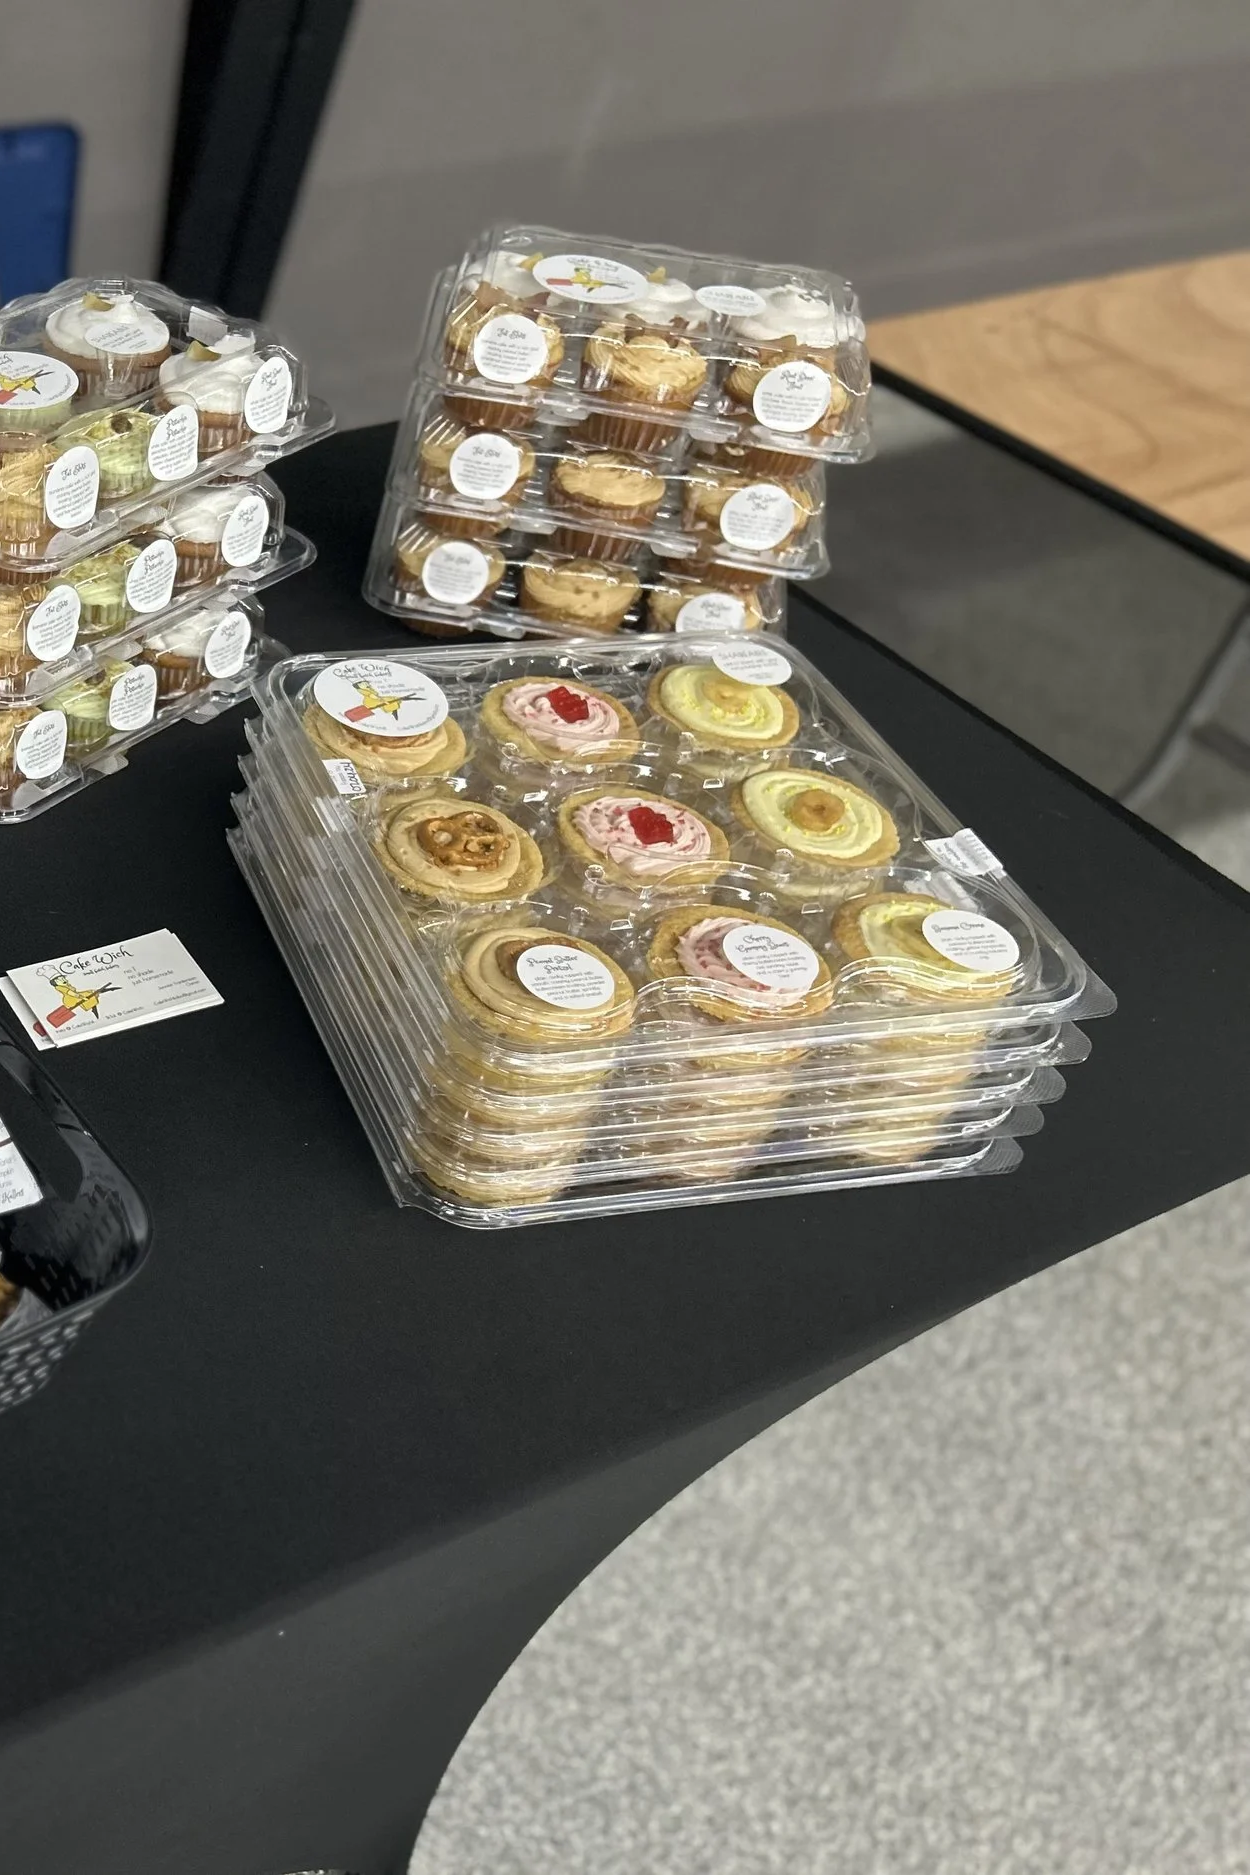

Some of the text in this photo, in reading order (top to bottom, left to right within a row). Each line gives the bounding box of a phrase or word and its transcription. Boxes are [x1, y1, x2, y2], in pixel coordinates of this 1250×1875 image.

[333, 663, 390, 678] Cake Wich
[743, 933, 772, 946] Cherry
[59, 944, 135, 975] Cake Wich
